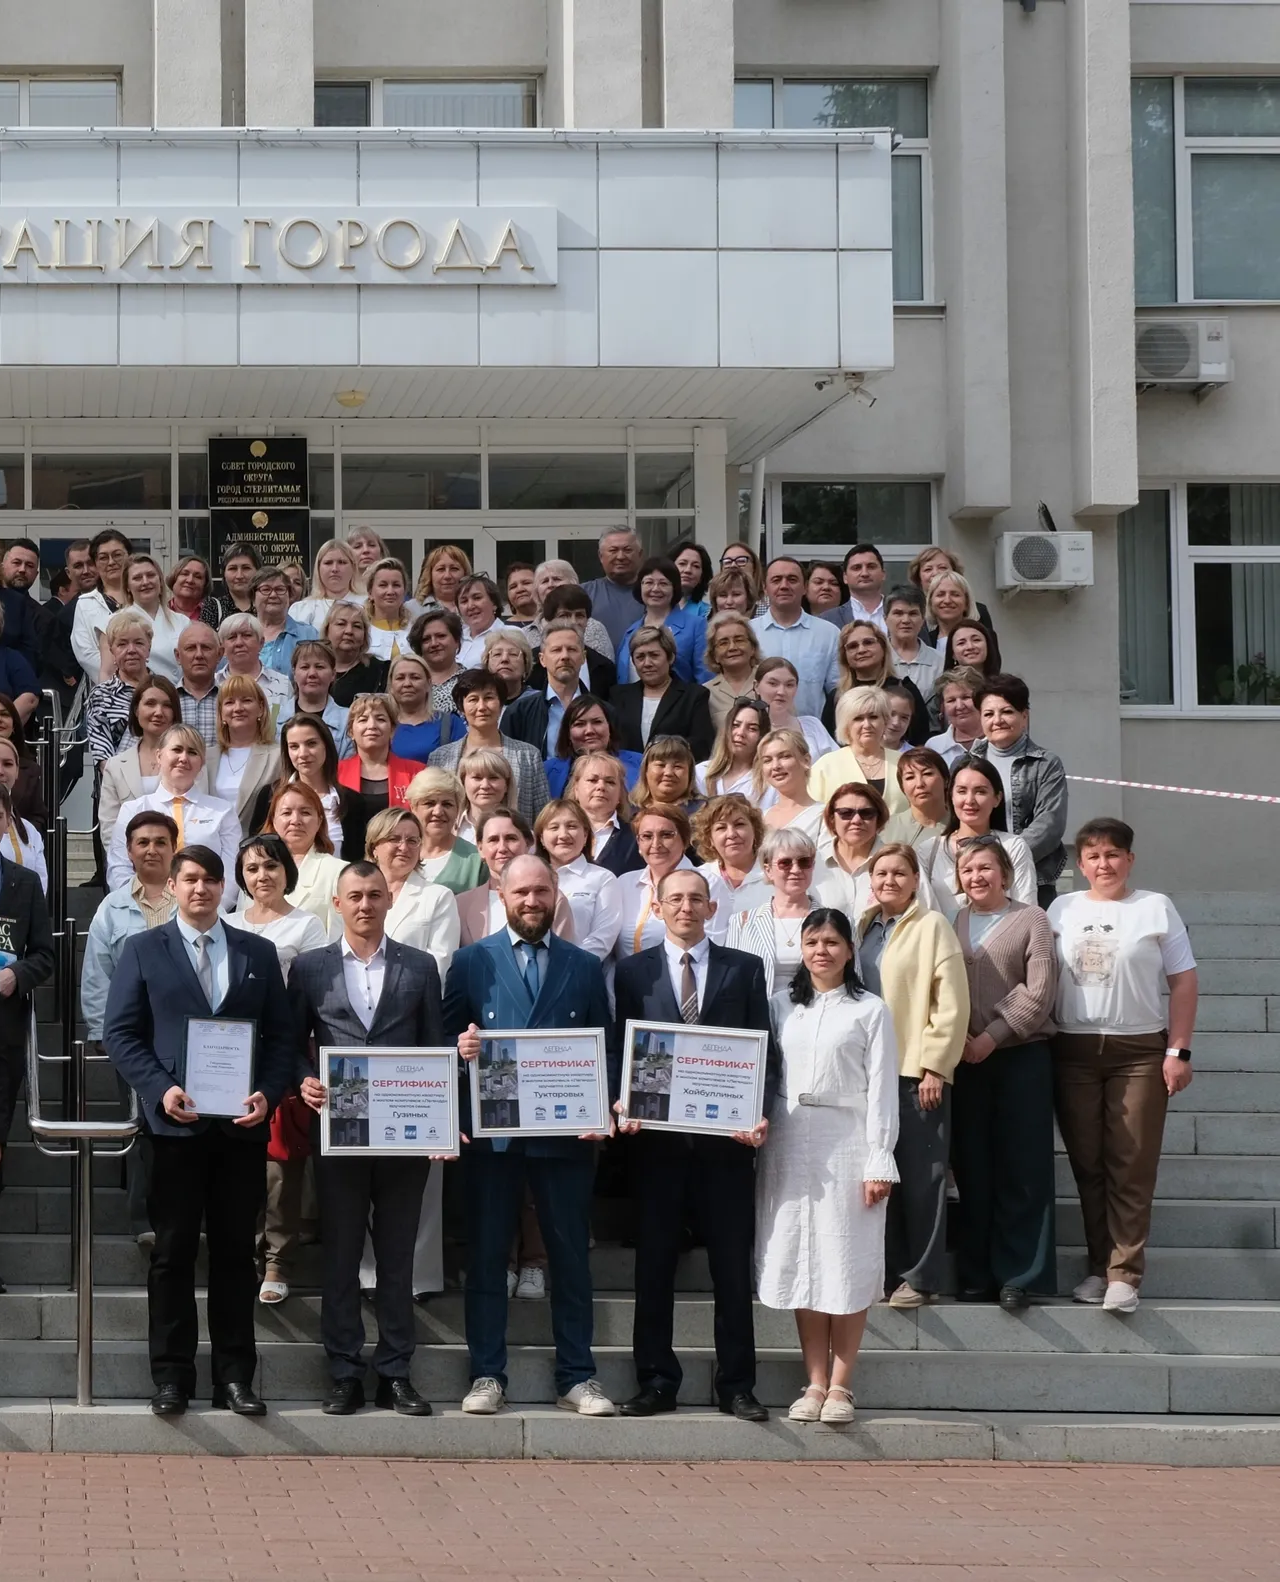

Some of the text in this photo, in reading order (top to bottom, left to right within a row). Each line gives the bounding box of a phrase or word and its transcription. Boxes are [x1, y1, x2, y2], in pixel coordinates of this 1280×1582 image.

[243, 216, 534, 275] ГОРОДА
[221, 462, 296, 472] СОВЕТ ГОРОДСКОГО
[243, 473, 273, 482] ОКРУГА
[217, 485, 301, 495] ГОРОД СТЕРЛИТАМАК
[226, 532, 295, 542] АДМИНИСТРАЦИЯ
[271, 544, 300, 553] ОКРУГА
[520, 1060, 597, 1068] СЕРТИФИКАТ
[676, 1056, 756, 1070] СЕРТИФИКАТ
[371, 1080, 449, 1088] СЕРТИФИКАТ
[533, 1091, 584, 1099] Туктаровых
[683, 1088, 744, 1100] Хайбуллиных
[392, 1111, 428, 1119] Гузиных
